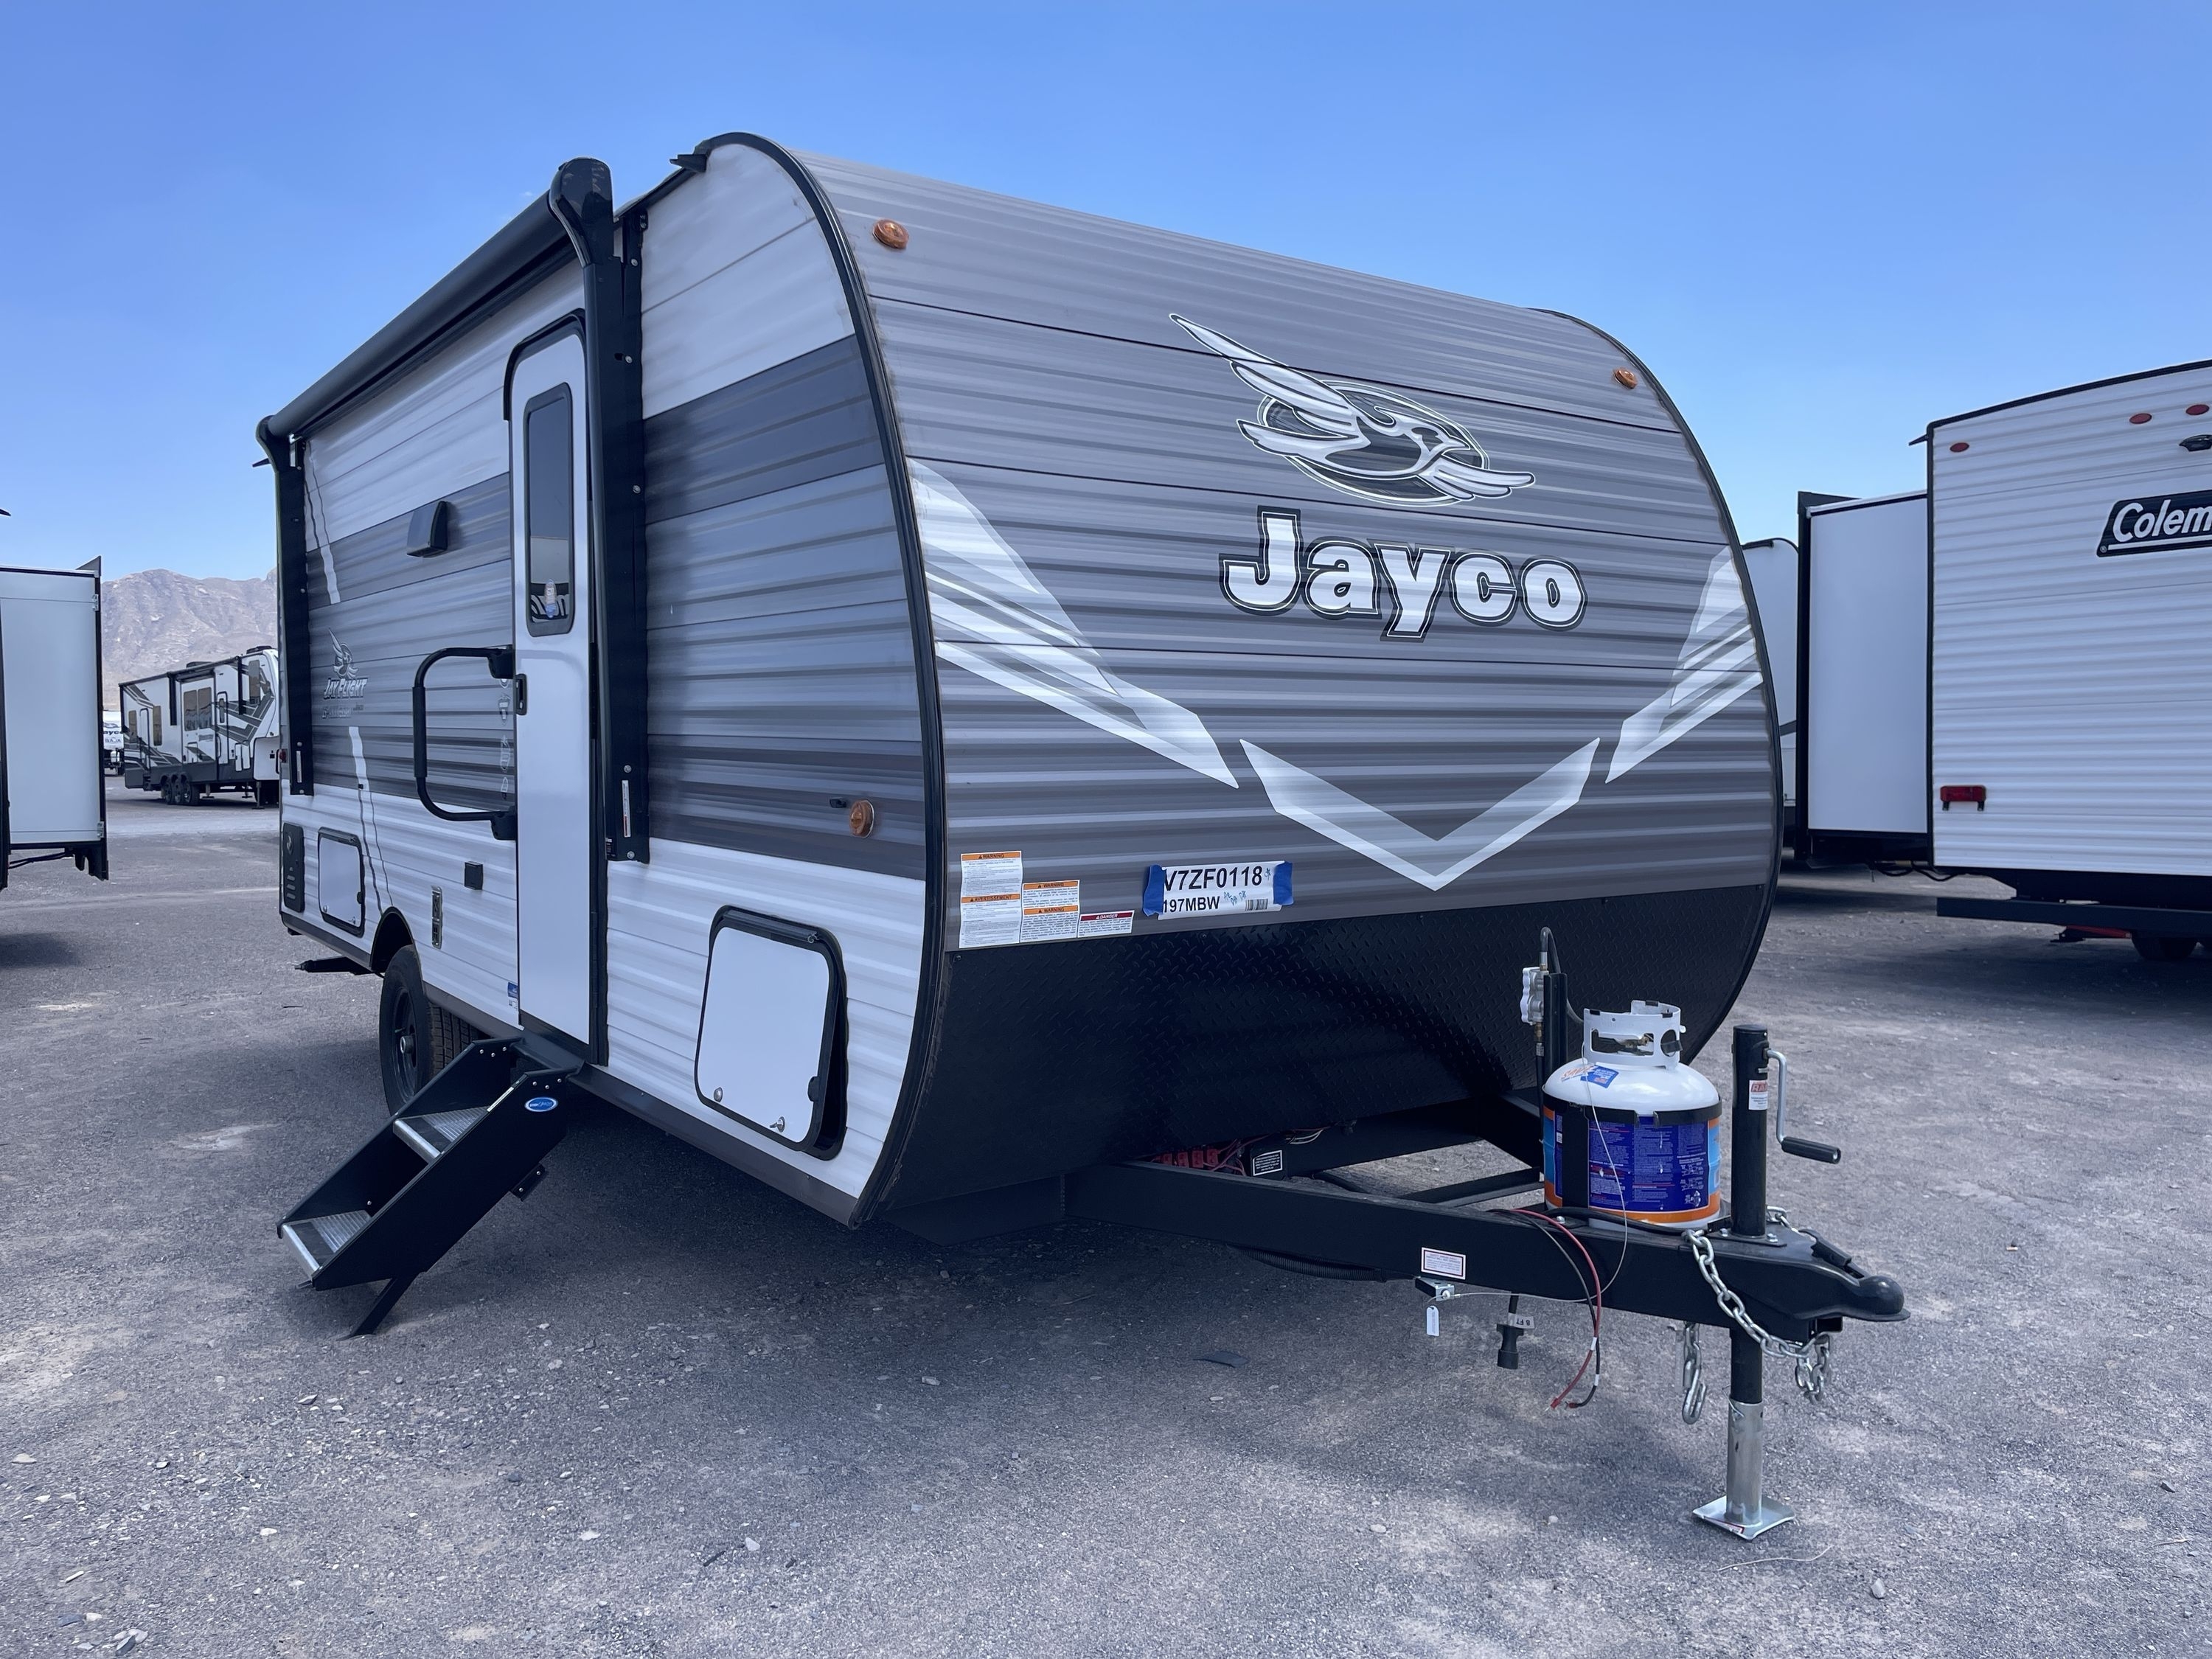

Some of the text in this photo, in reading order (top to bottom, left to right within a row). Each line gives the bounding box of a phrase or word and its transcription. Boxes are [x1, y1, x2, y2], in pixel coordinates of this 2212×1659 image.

[2112, 498, 2212, 543] Colem
[1221, 508, 1585, 639] Jayco
[1164, 866, 1262, 891] V7ZF0118
[1164, 896, 1220, 913] 197MBW
